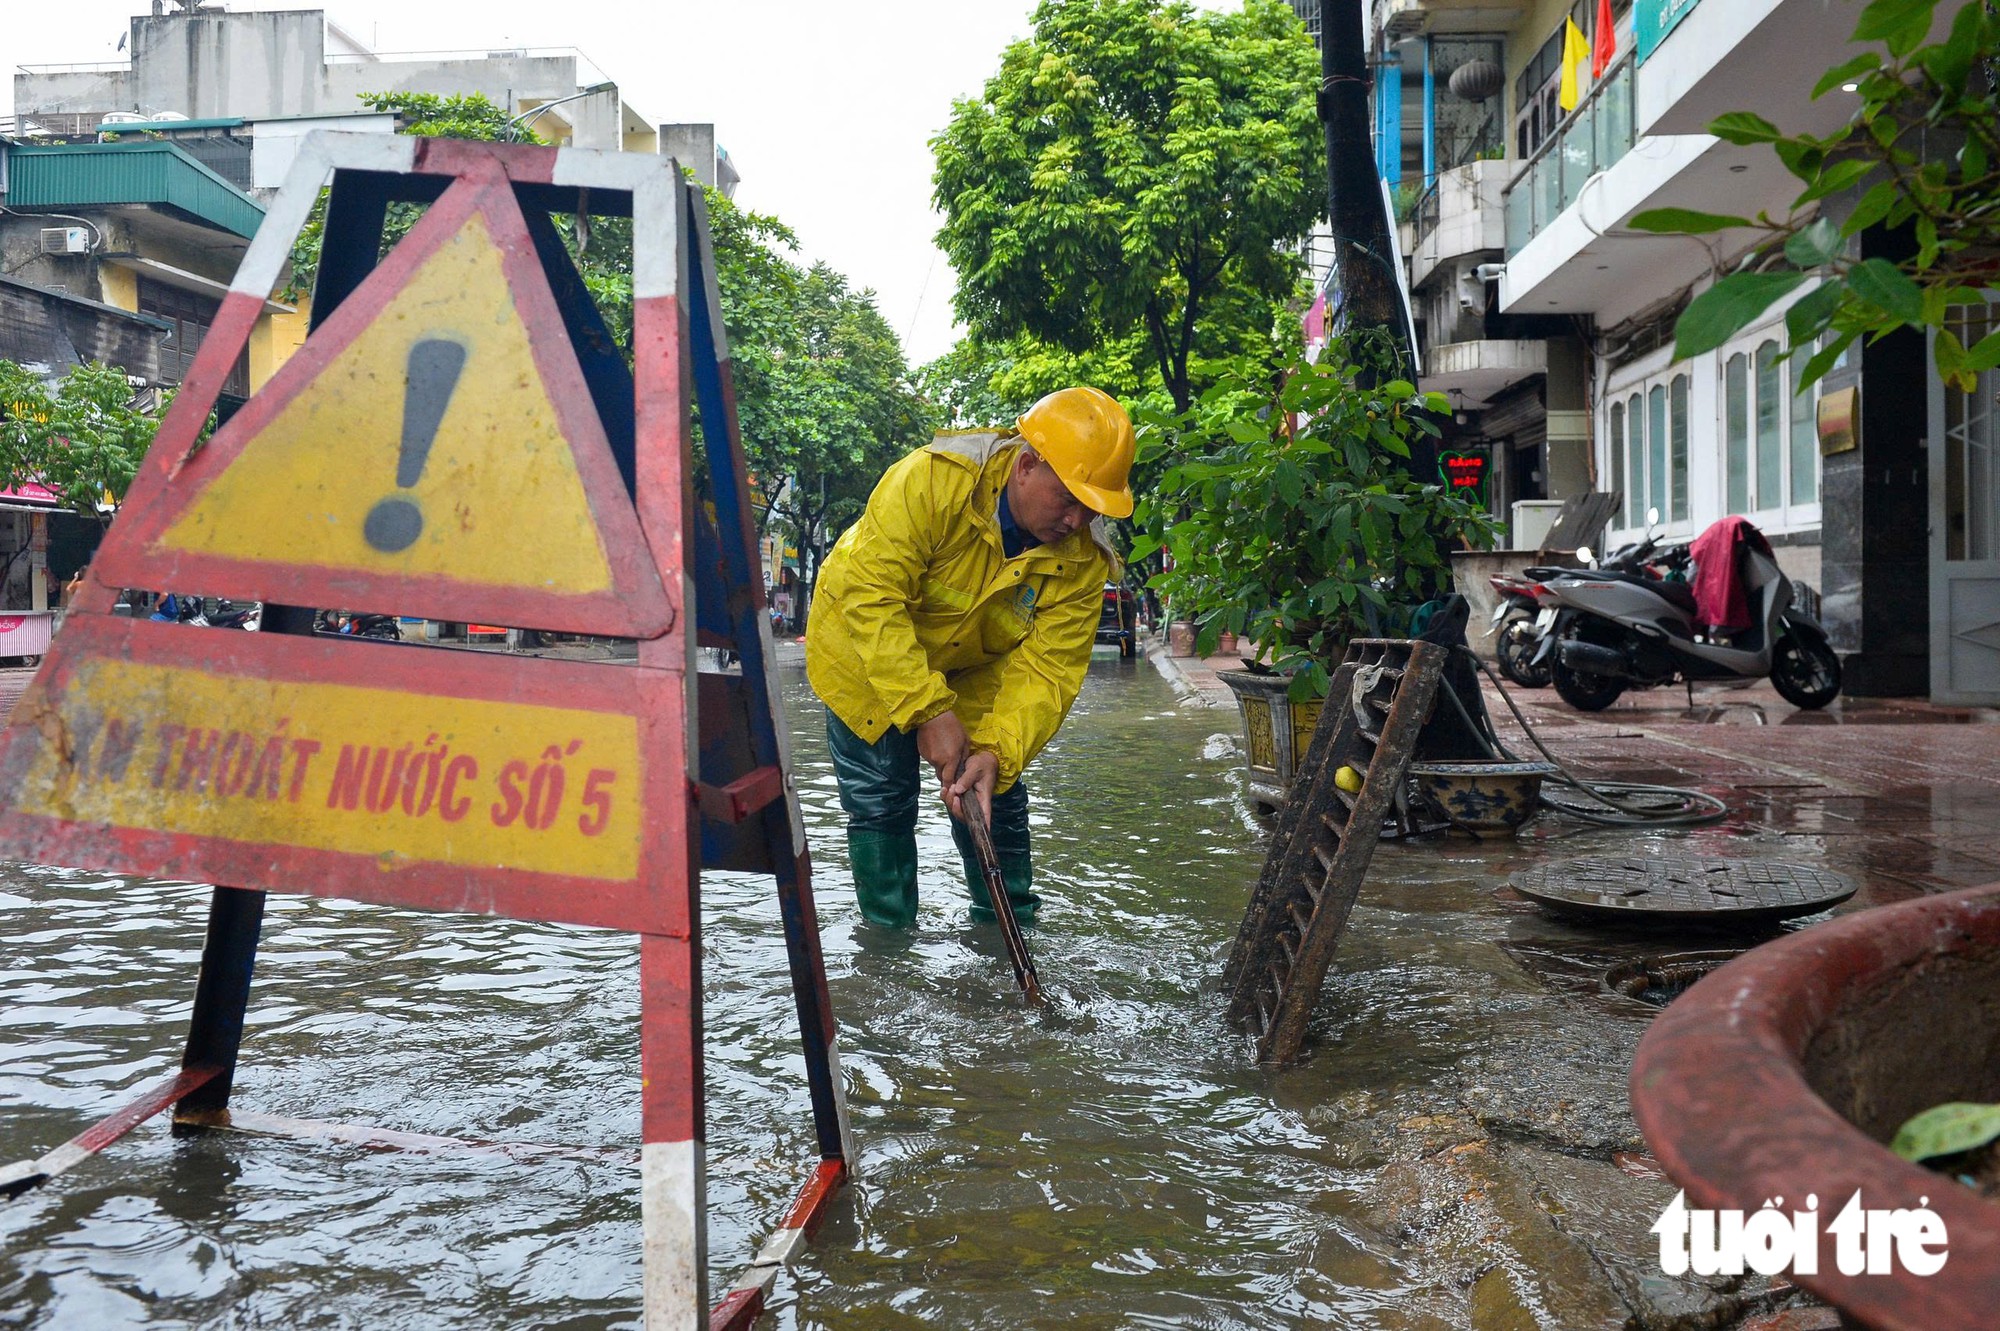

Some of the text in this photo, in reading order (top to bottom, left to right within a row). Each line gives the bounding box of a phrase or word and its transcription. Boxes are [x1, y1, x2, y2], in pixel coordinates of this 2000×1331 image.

[151, 716, 322, 803] THOÁT
[326, 732, 478, 823] NƯỚC
[490, 738, 584, 831] SỐ
[578, 768, 617, 837] 5
